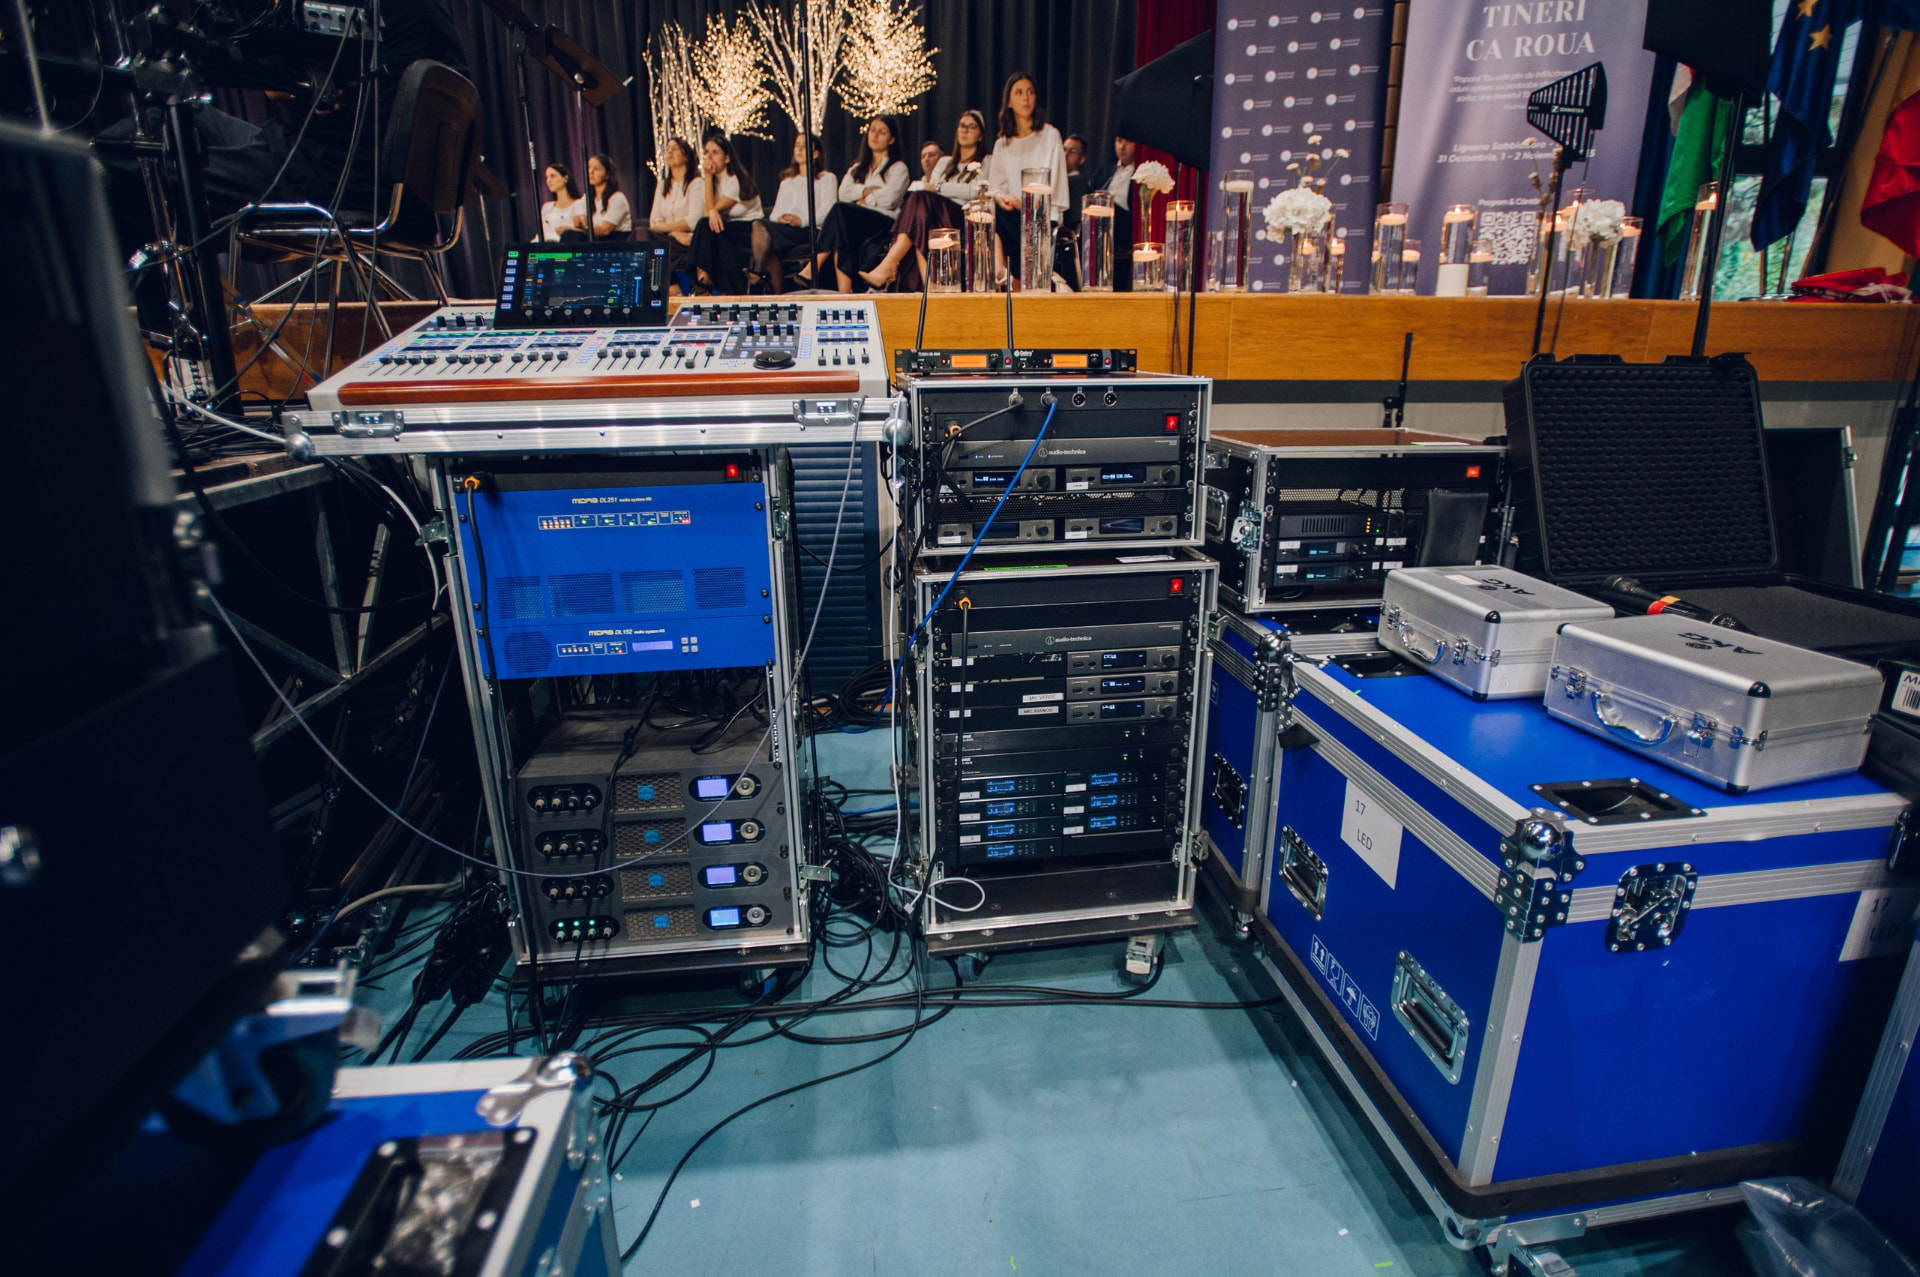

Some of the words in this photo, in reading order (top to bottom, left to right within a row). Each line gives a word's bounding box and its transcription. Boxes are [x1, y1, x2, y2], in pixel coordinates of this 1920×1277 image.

[1483, 0, 1587, 28] TINERI
[1466, 38, 1503, 62] CA
[1513, 31, 1596, 59] ROUA
[1355, 799, 1366, 816] 17
[1356, 828, 1373, 851] LED
[1870, 896, 1892, 913] 17
